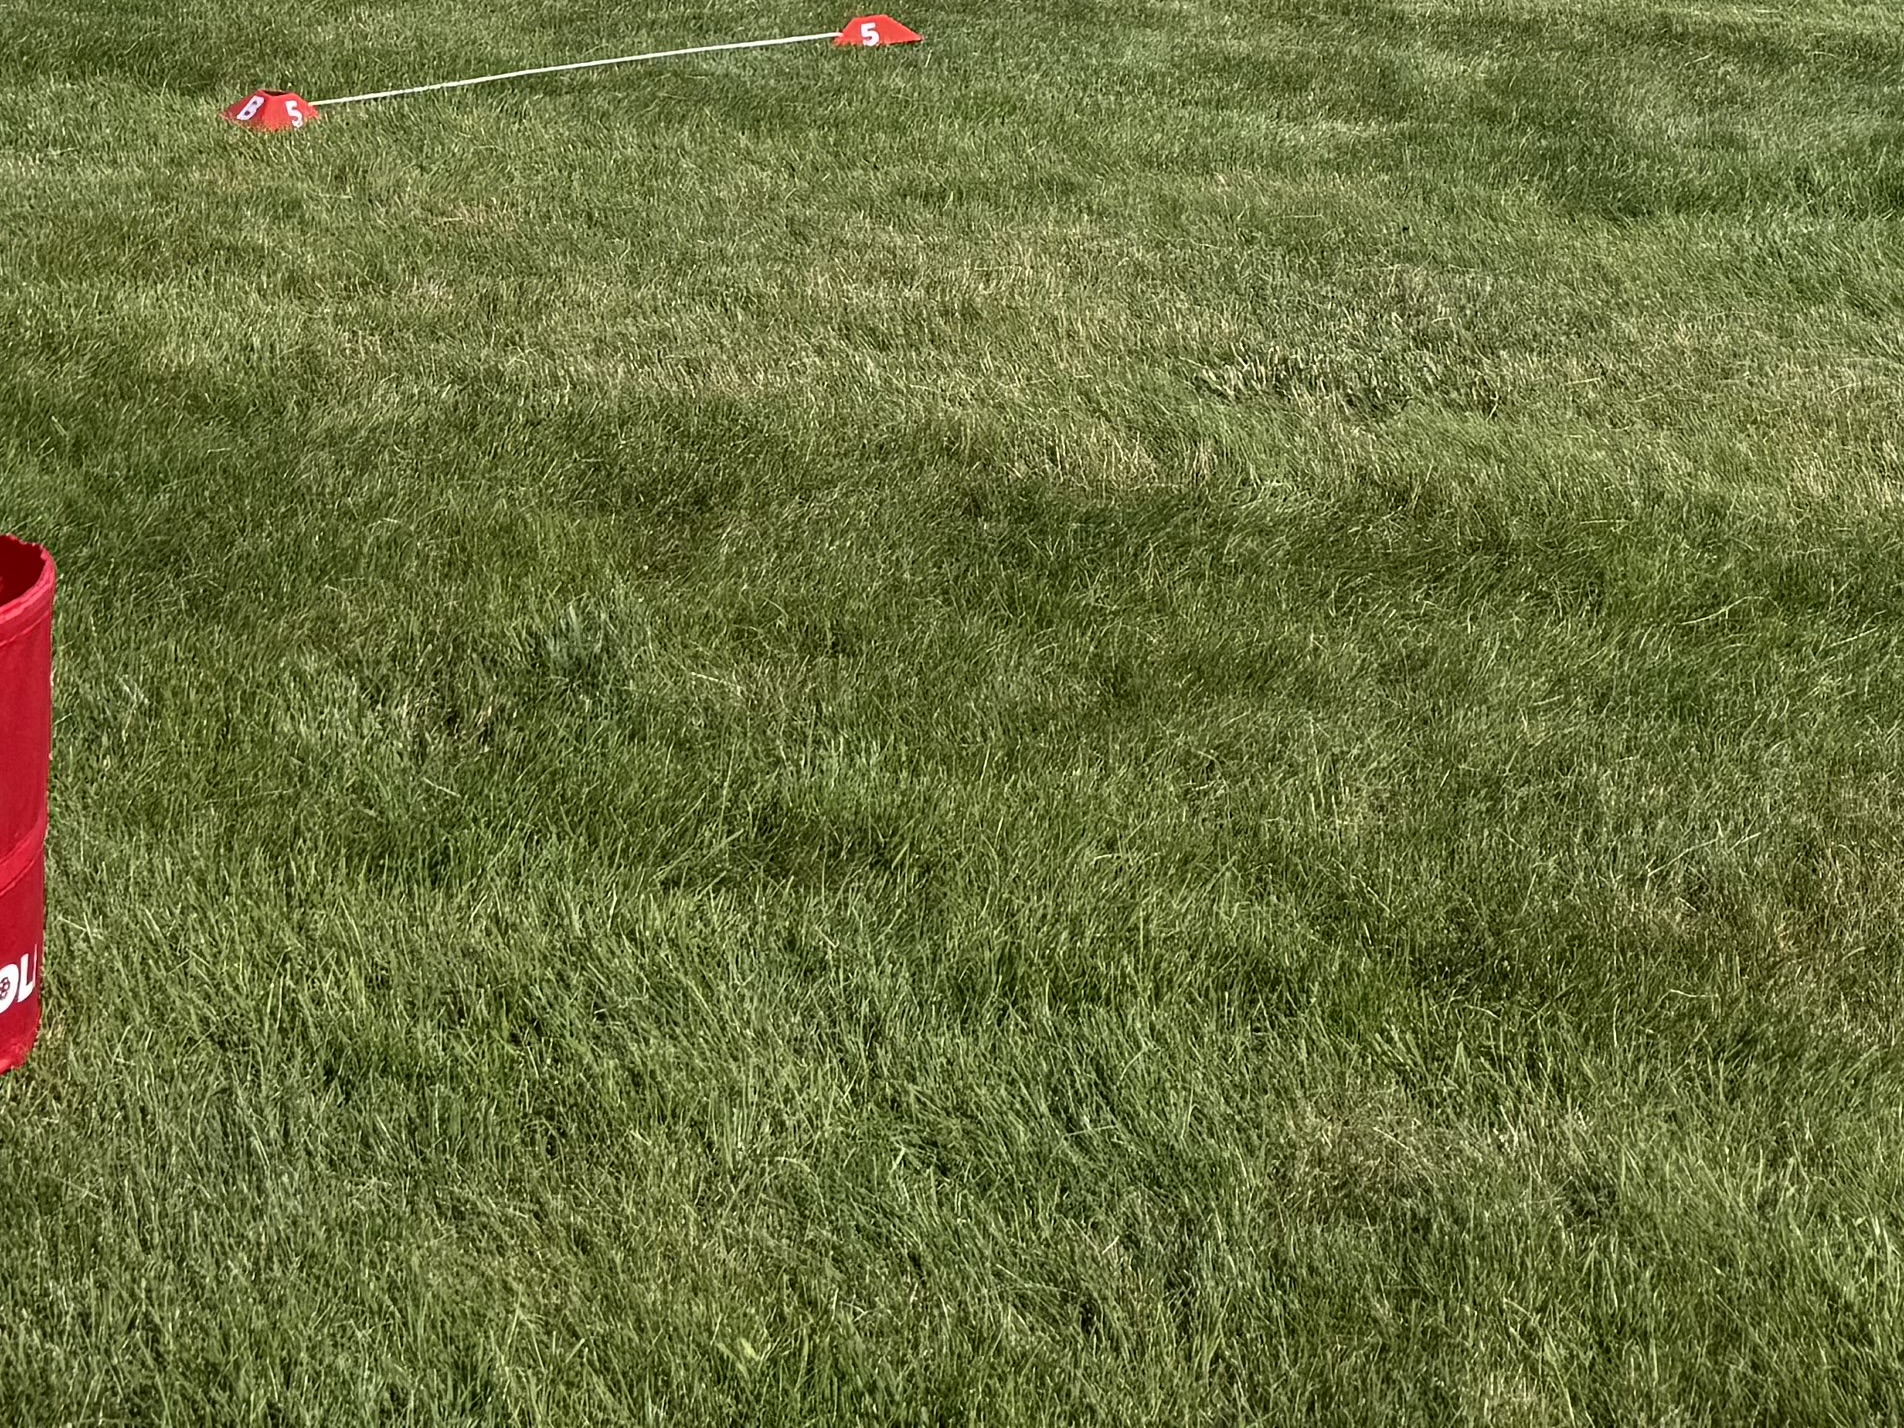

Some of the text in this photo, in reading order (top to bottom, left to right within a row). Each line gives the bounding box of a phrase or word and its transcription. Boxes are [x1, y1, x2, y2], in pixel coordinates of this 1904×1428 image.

[860, 22, 880, 47] 5
[236, 95, 265, 121] B
[285, 100, 304, 128] 5
